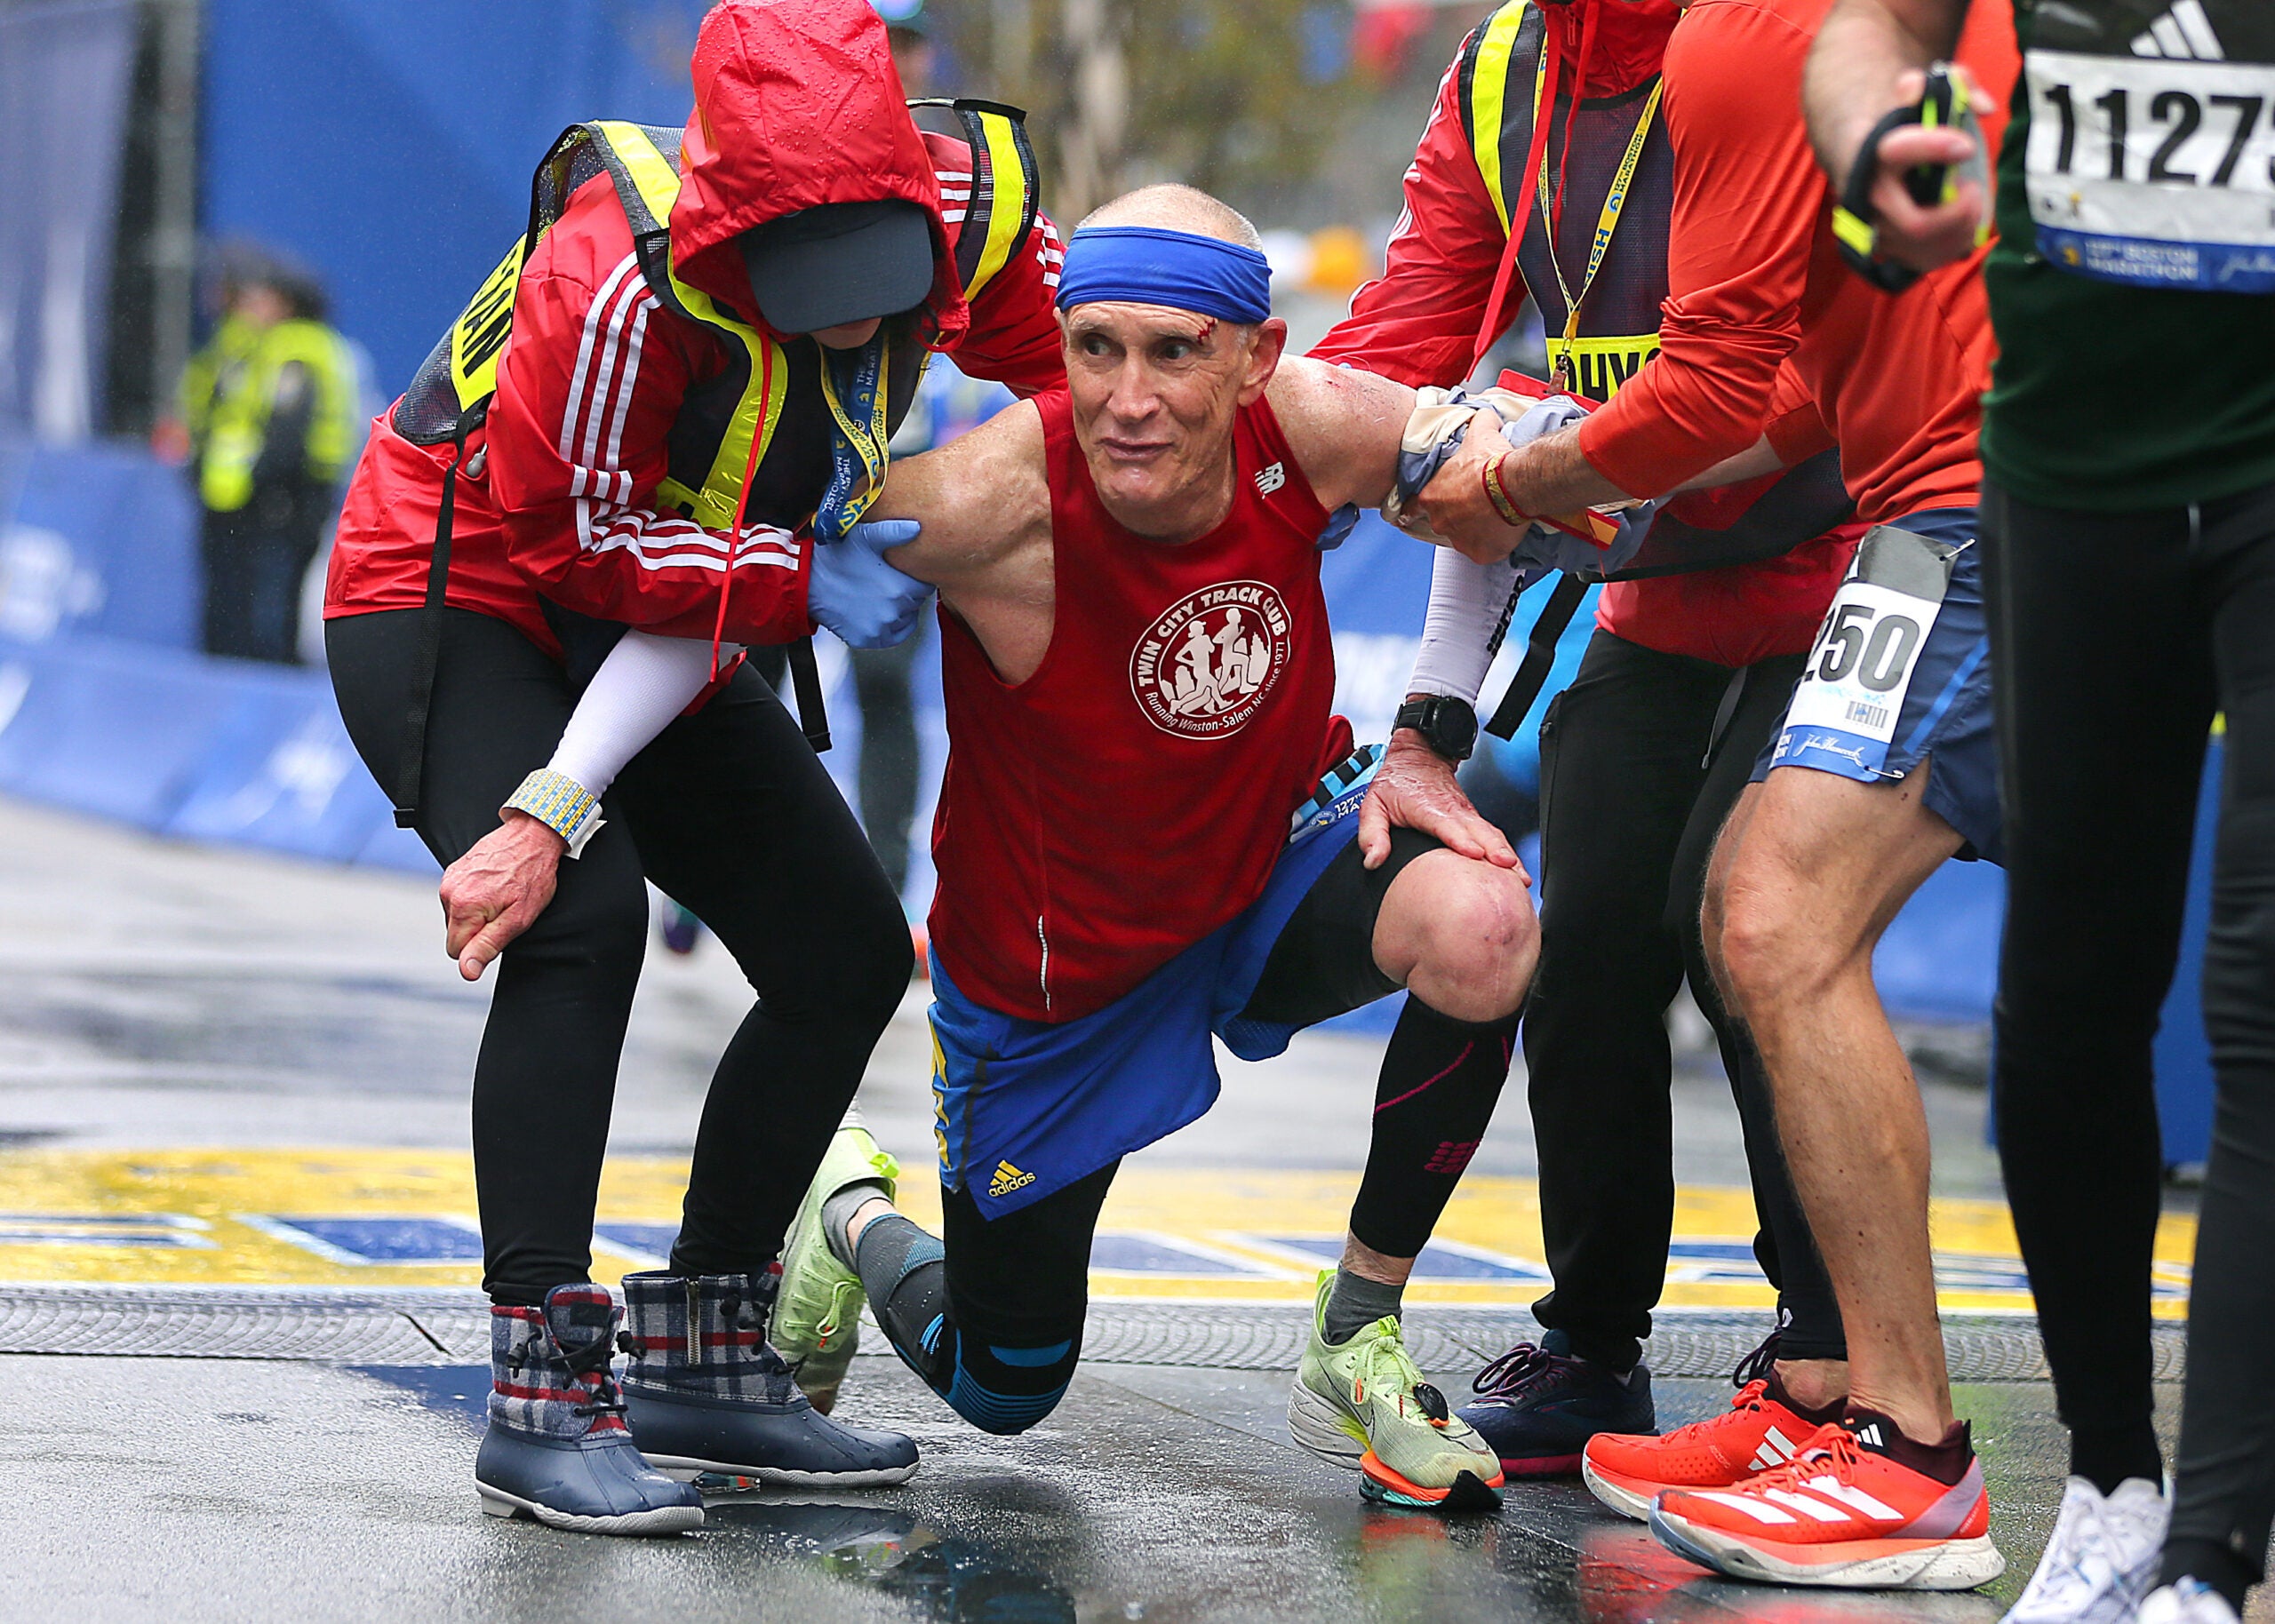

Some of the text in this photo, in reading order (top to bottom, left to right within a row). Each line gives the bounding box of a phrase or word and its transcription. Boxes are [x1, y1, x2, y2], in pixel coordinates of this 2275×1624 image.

[1618, 134, 1643, 192] MARATHON
[2045, 84, 2275, 188] 1127
[1138, 586, 1287, 688] TWIN CITY TRACK CLUB
[1145, 641, 1286, 732] Running Winston-Salem NC since 1977
[988, 1172, 1037, 1198] adidas
